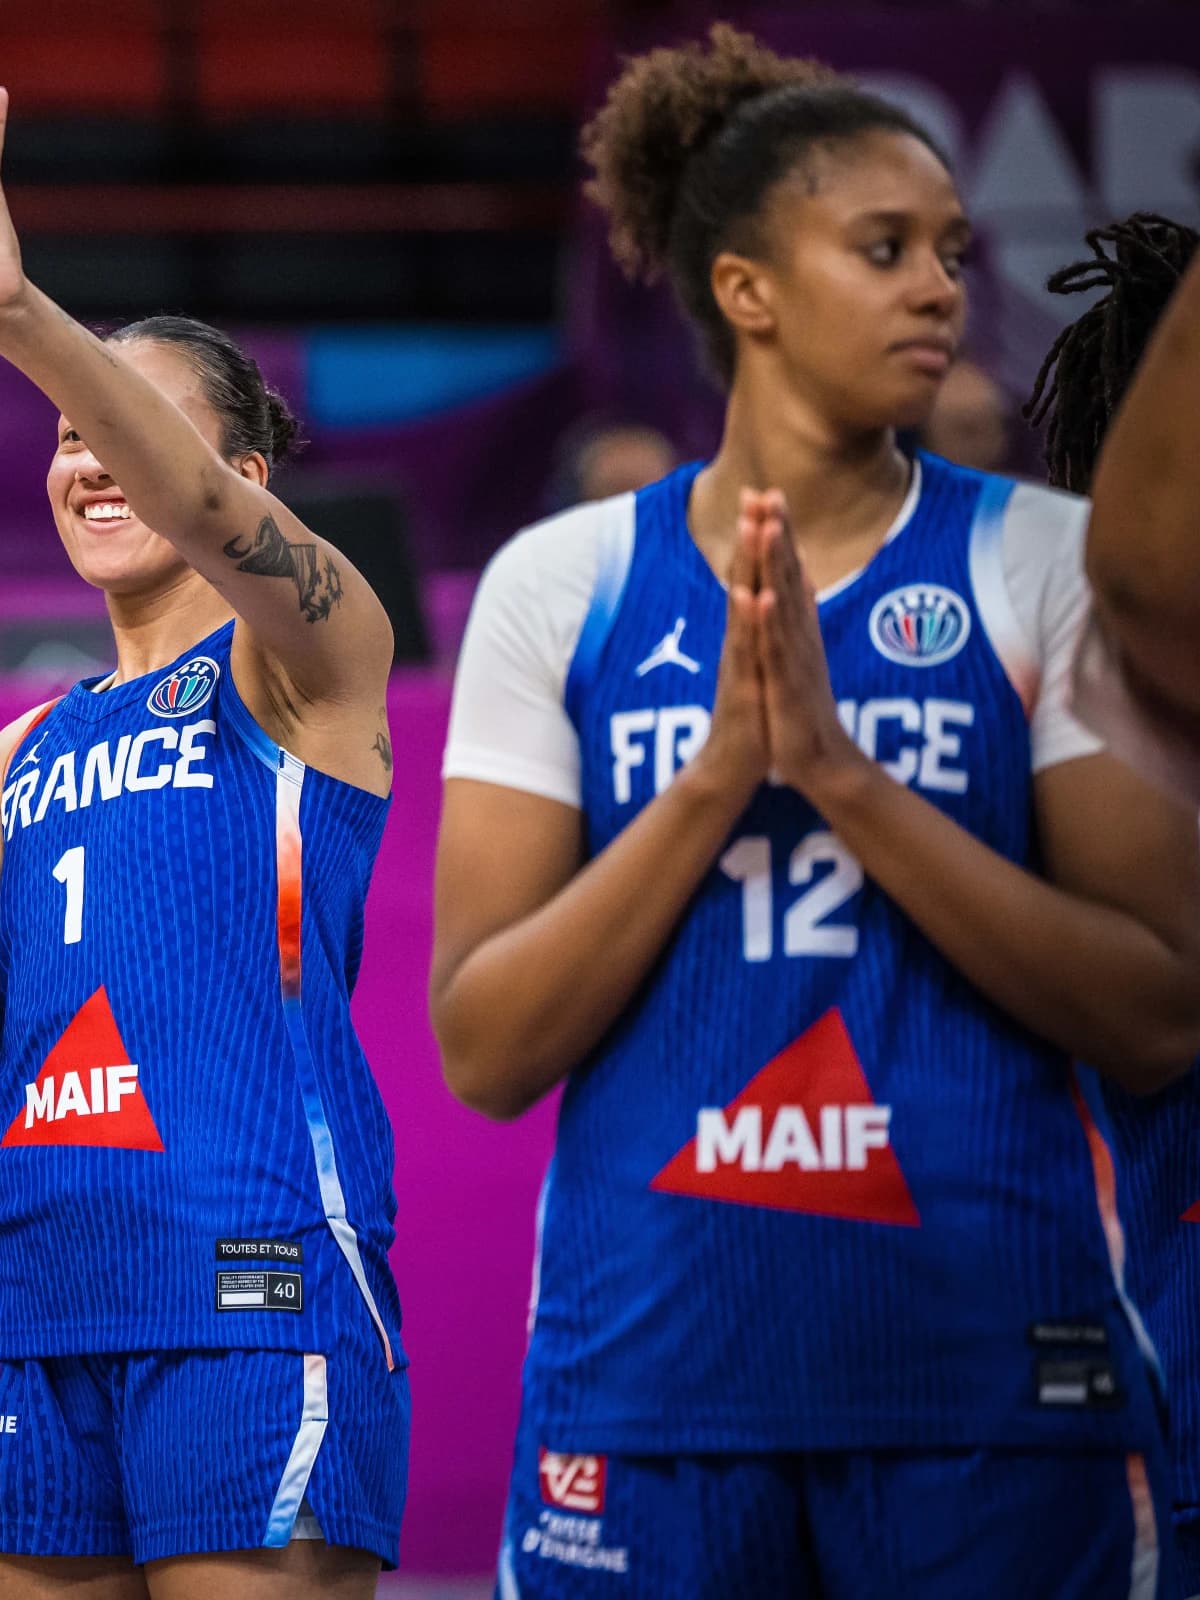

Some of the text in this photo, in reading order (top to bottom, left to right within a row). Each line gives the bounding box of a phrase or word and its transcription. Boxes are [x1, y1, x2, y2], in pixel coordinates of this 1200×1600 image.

[0, 719, 217, 842] FRANCE
[609, 695, 975, 805] FRCE
[52, 846, 85, 945] 1
[719, 831, 866, 963] 12
[24, 1063, 139, 1129] MAIF
[695, 1103, 892, 1173] MAIF
[220, 1244, 299, 1257] TOUTES ET TOUS
[273, 1282, 296, 1299] 40
